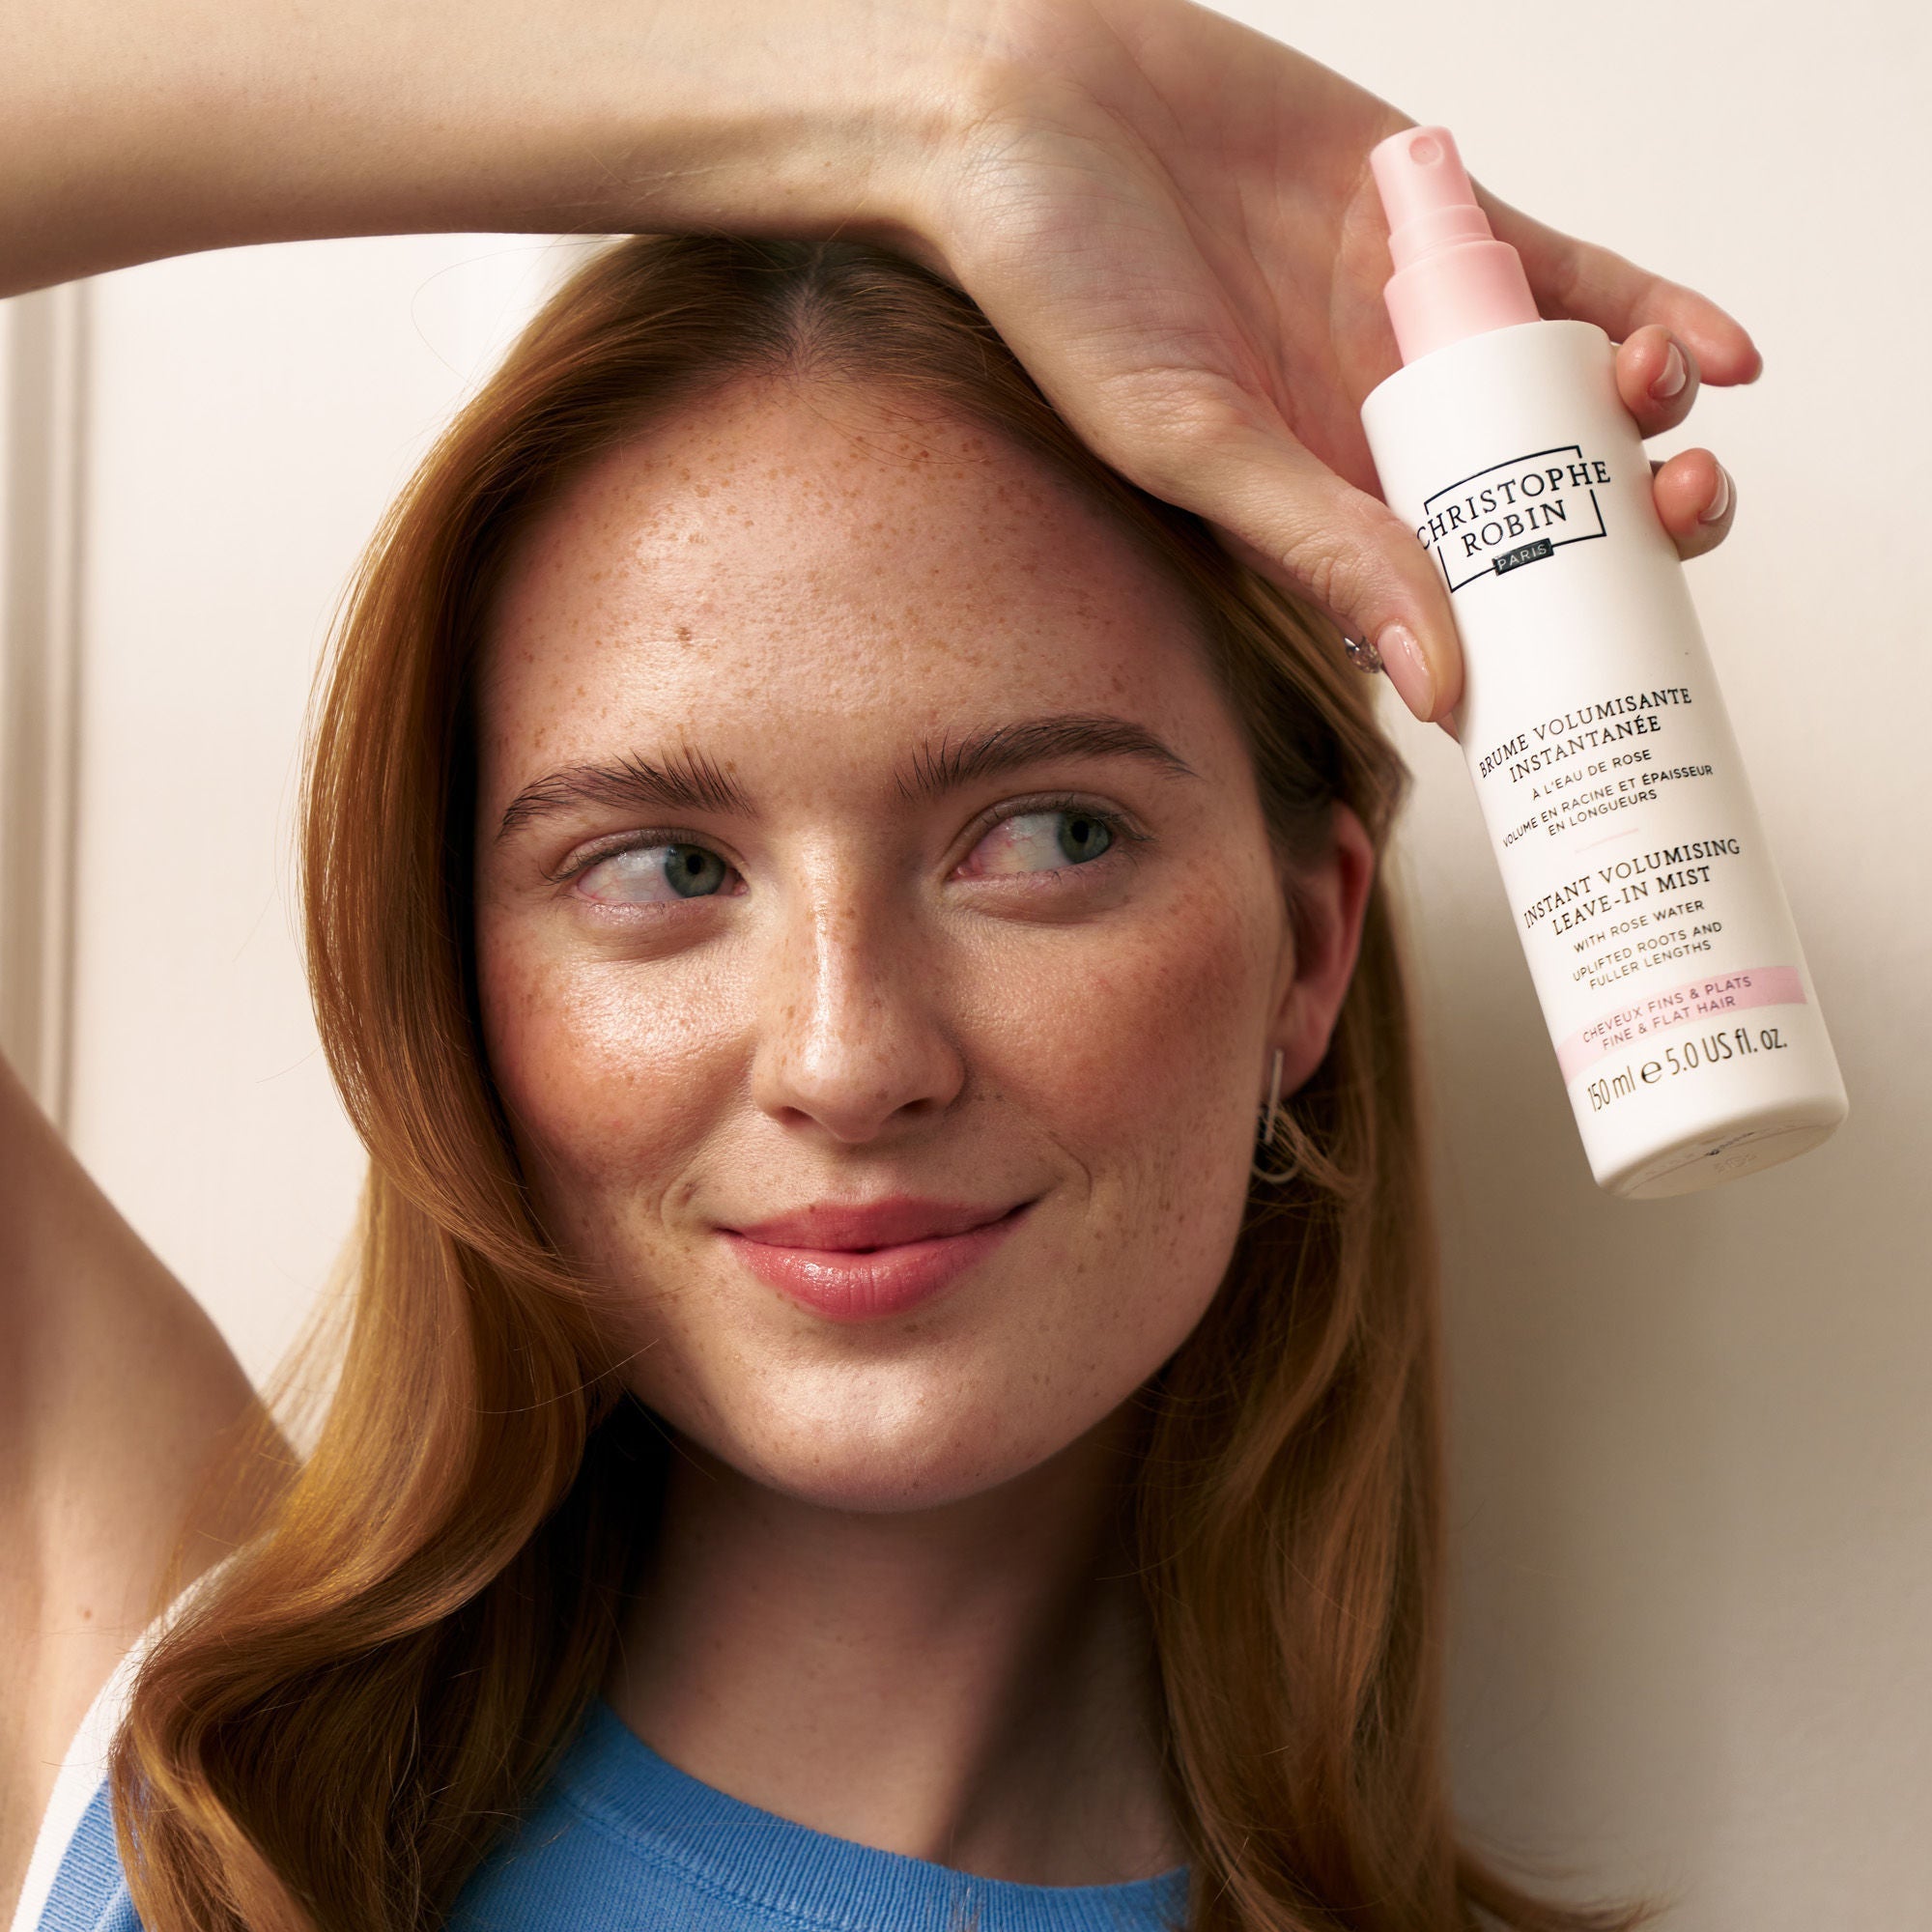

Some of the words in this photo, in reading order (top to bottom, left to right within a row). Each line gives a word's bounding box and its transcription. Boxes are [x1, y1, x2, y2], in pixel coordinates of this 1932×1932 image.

[1417, 461, 1610, 550] CHRISTOPHE
[1461, 499, 1566, 557] ROBIN
[1496, 543, 1548, 571] PARIS
[1479, 734, 1529, 779] BRUME
[1533, 688, 1692, 740] VOLUMISANTE
[1509, 715, 1662, 783] INSTANTANÉE
[1502, 817, 1538, 847] VOLUME
[1541, 807, 1558, 823] EN
[1562, 785, 1613, 812] RACINE
[1619, 778, 1635, 792] ET
[1642, 764, 1713, 785] ÉPAISSEUR
[1532, 787, 1541, 801] À
[1545, 771, 1582, 794] L'EAU
[1588, 763, 1608, 777] DE
[1612, 749, 1652, 768] ROSE
[1548, 821, 1565, 837] EN
[1570, 789, 1658, 827] LONGUEURS
[1523, 876, 1591, 929] INSTANT
[1598, 838, 1740, 884] VOLUMISING
[1552, 882, 1649, 936] LEAVE-IN
[1657, 866, 1711, 894] MIST
[1573, 948, 1633, 981] UPLIFTED
[1637, 929, 1687, 952] ROOTS
[1692, 922, 1722, 937] AND
[1574, 932, 1606, 953] WITH
[1610, 916, 1649, 936] ROSE
[1653, 900, 1705, 922] WATER
[1589, 961, 1639, 990] FULLER
[1645, 940, 1712, 968] LENGTHS
[1582, 1006, 1643, 1044] CHEVEUX
[1648, 992, 1684, 1013] FINS
[1690, 988, 1700, 1000] &
[1704, 976, 1752, 996] PLATS
[1602, 1028, 1634, 1051] FINE
[1638, 1023, 1647, 1035] &
[1653, 1008, 1690, 1029] FLAT
[1696, 996, 1736, 1014] HAIR
[1587, 1078, 1611, 1112] 150
[1612, 1065, 1636, 1099] ml
[1665, 1041, 1700, 1075] 5.0
[1701, 1032, 1733, 1063] US
[1735, 1027, 1758, 1055] fl.
[1760, 1028, 1788, 1050] oz.
